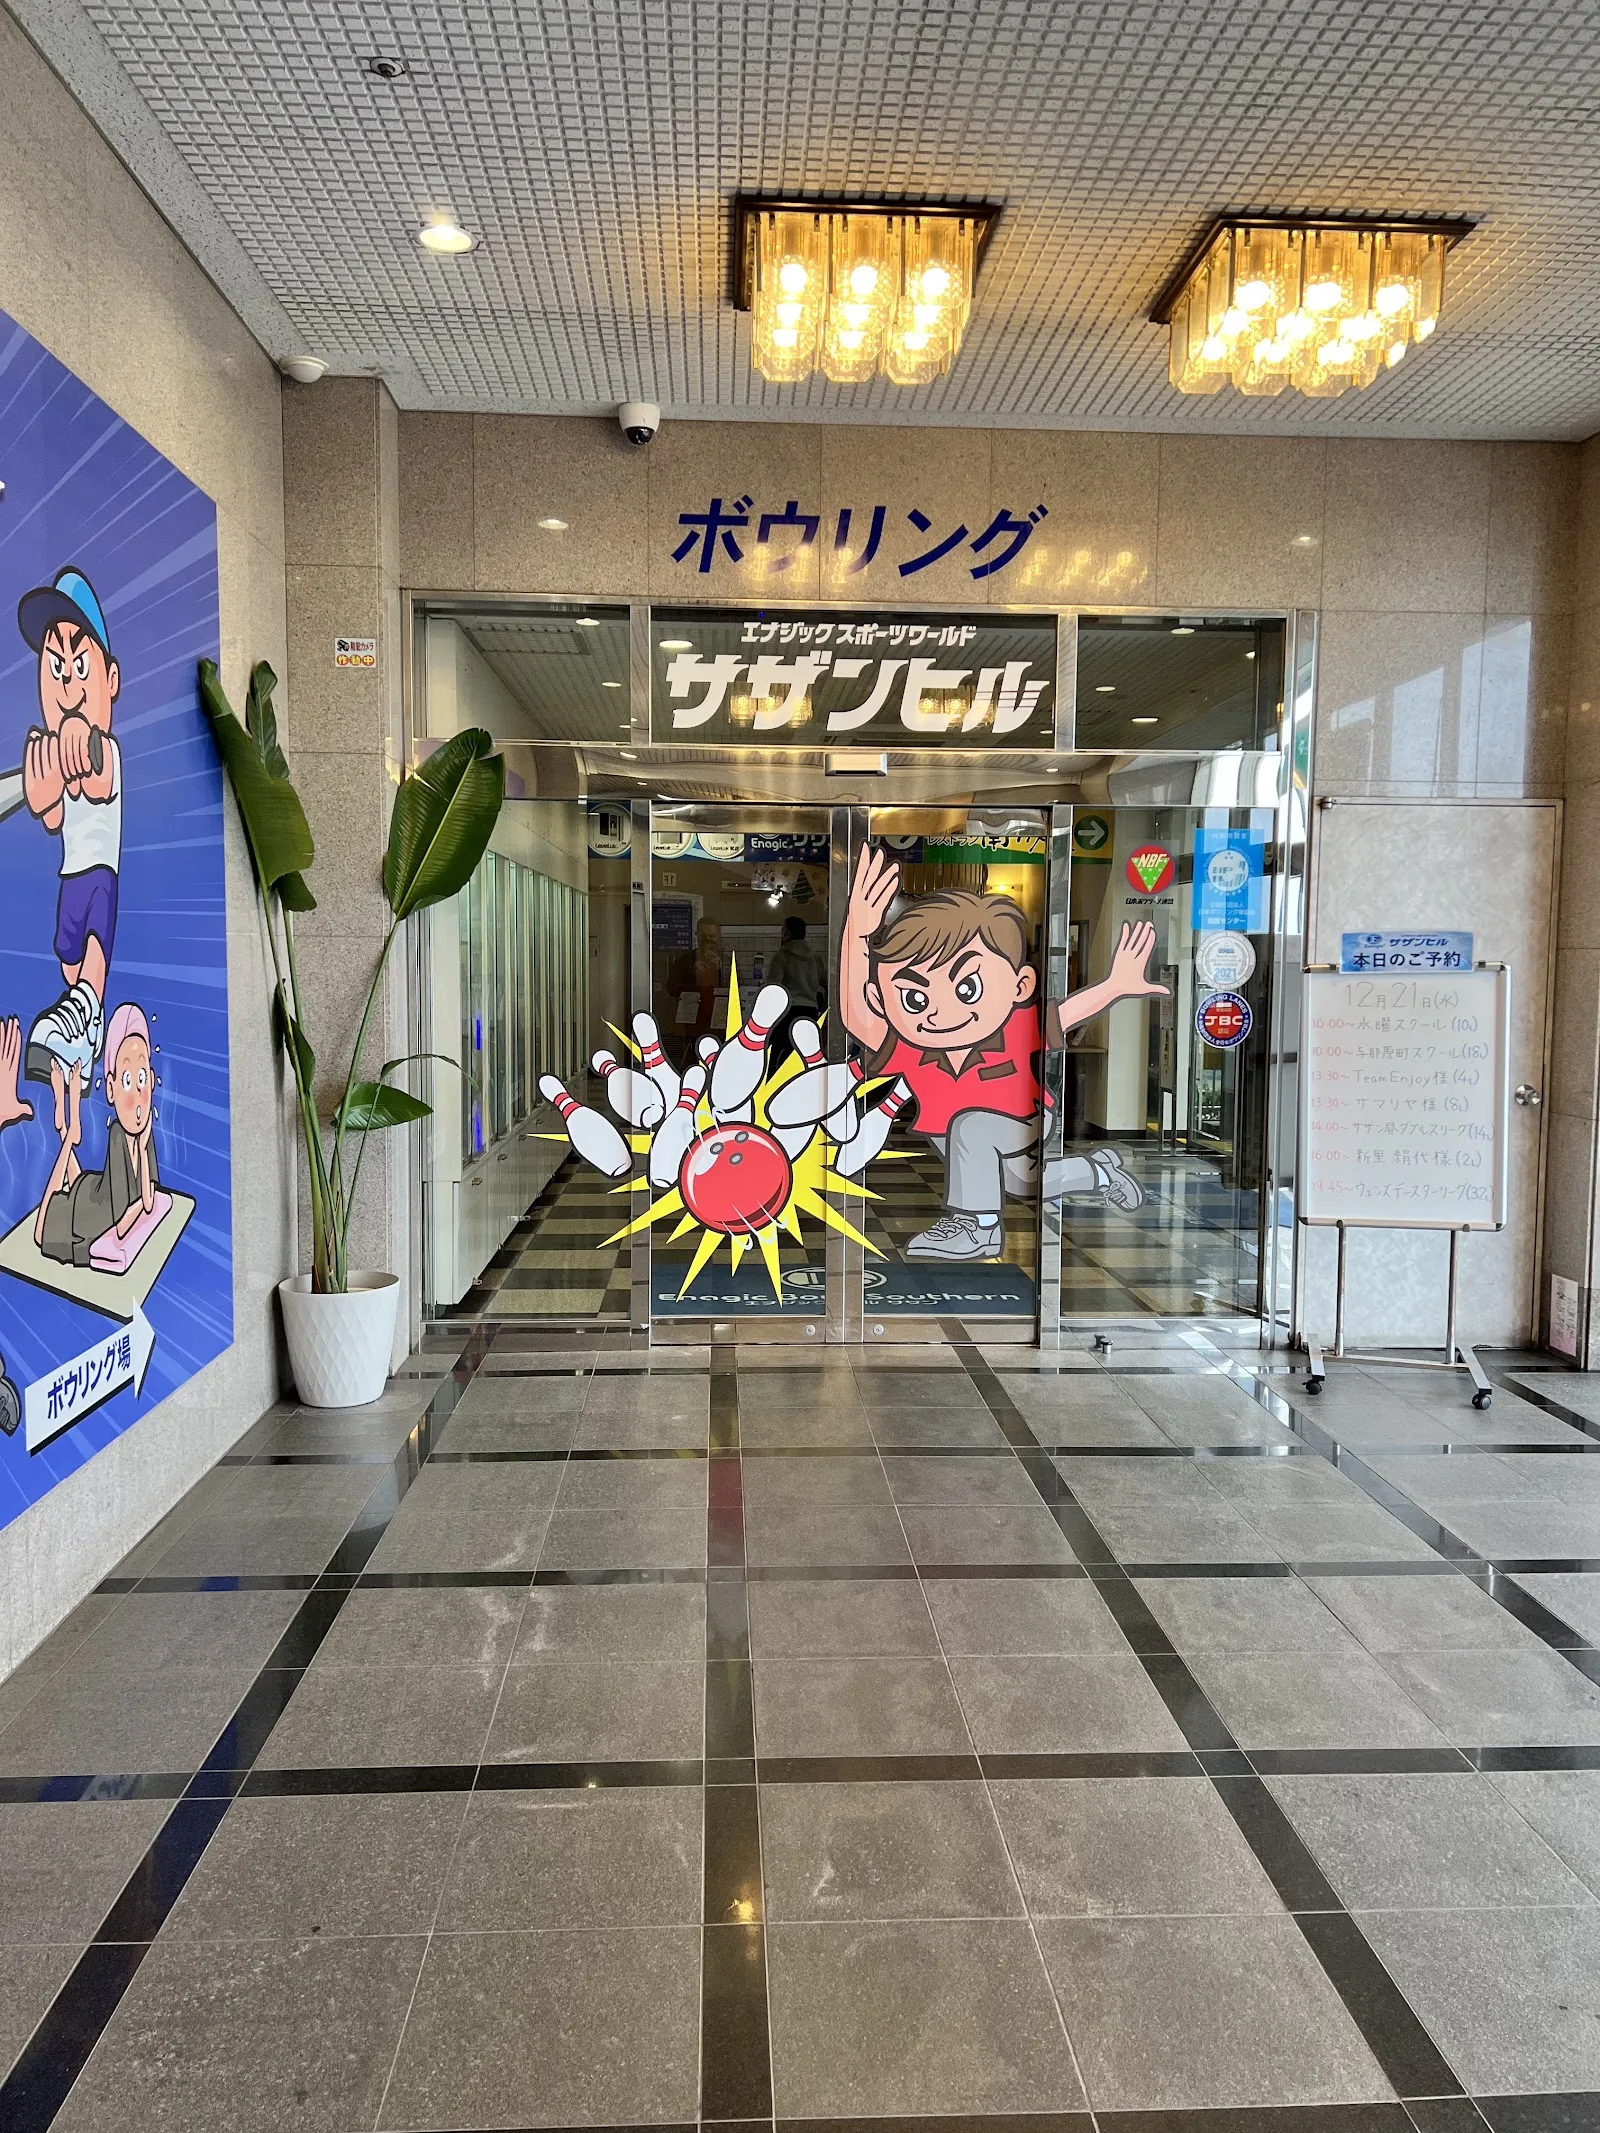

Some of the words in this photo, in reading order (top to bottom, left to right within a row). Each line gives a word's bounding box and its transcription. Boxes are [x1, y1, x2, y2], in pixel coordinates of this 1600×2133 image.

[671, 494, 1048, 580] ボウリング
[741, 621, 836, 645] エナジック
[837, 623, 976, 647] スポーツワールド
[337, 655, 373, 666] 作動中
[666, 651, 1049, 734] サザンヒル
[751, 838, 788, 851] Enagic
[1138, 853, 1168, 868] NBF
[1390, 938, 1448, 947] サザンヒル
[1353, 950, 1461, 968] 本日のご予約
[1215, 967, 1237, 978] 2021
[1199, 994, 1228, 1015] BOWLING
[1229, 995, 1248, 1014] LANES
[1204, 1015, 1244, 1026] JBC
[658, 1292, 769, 1303] Enagic
[865, 1292, 1021, 1301] Southern
[47, 1333, 131, 1420] ボウリング場
